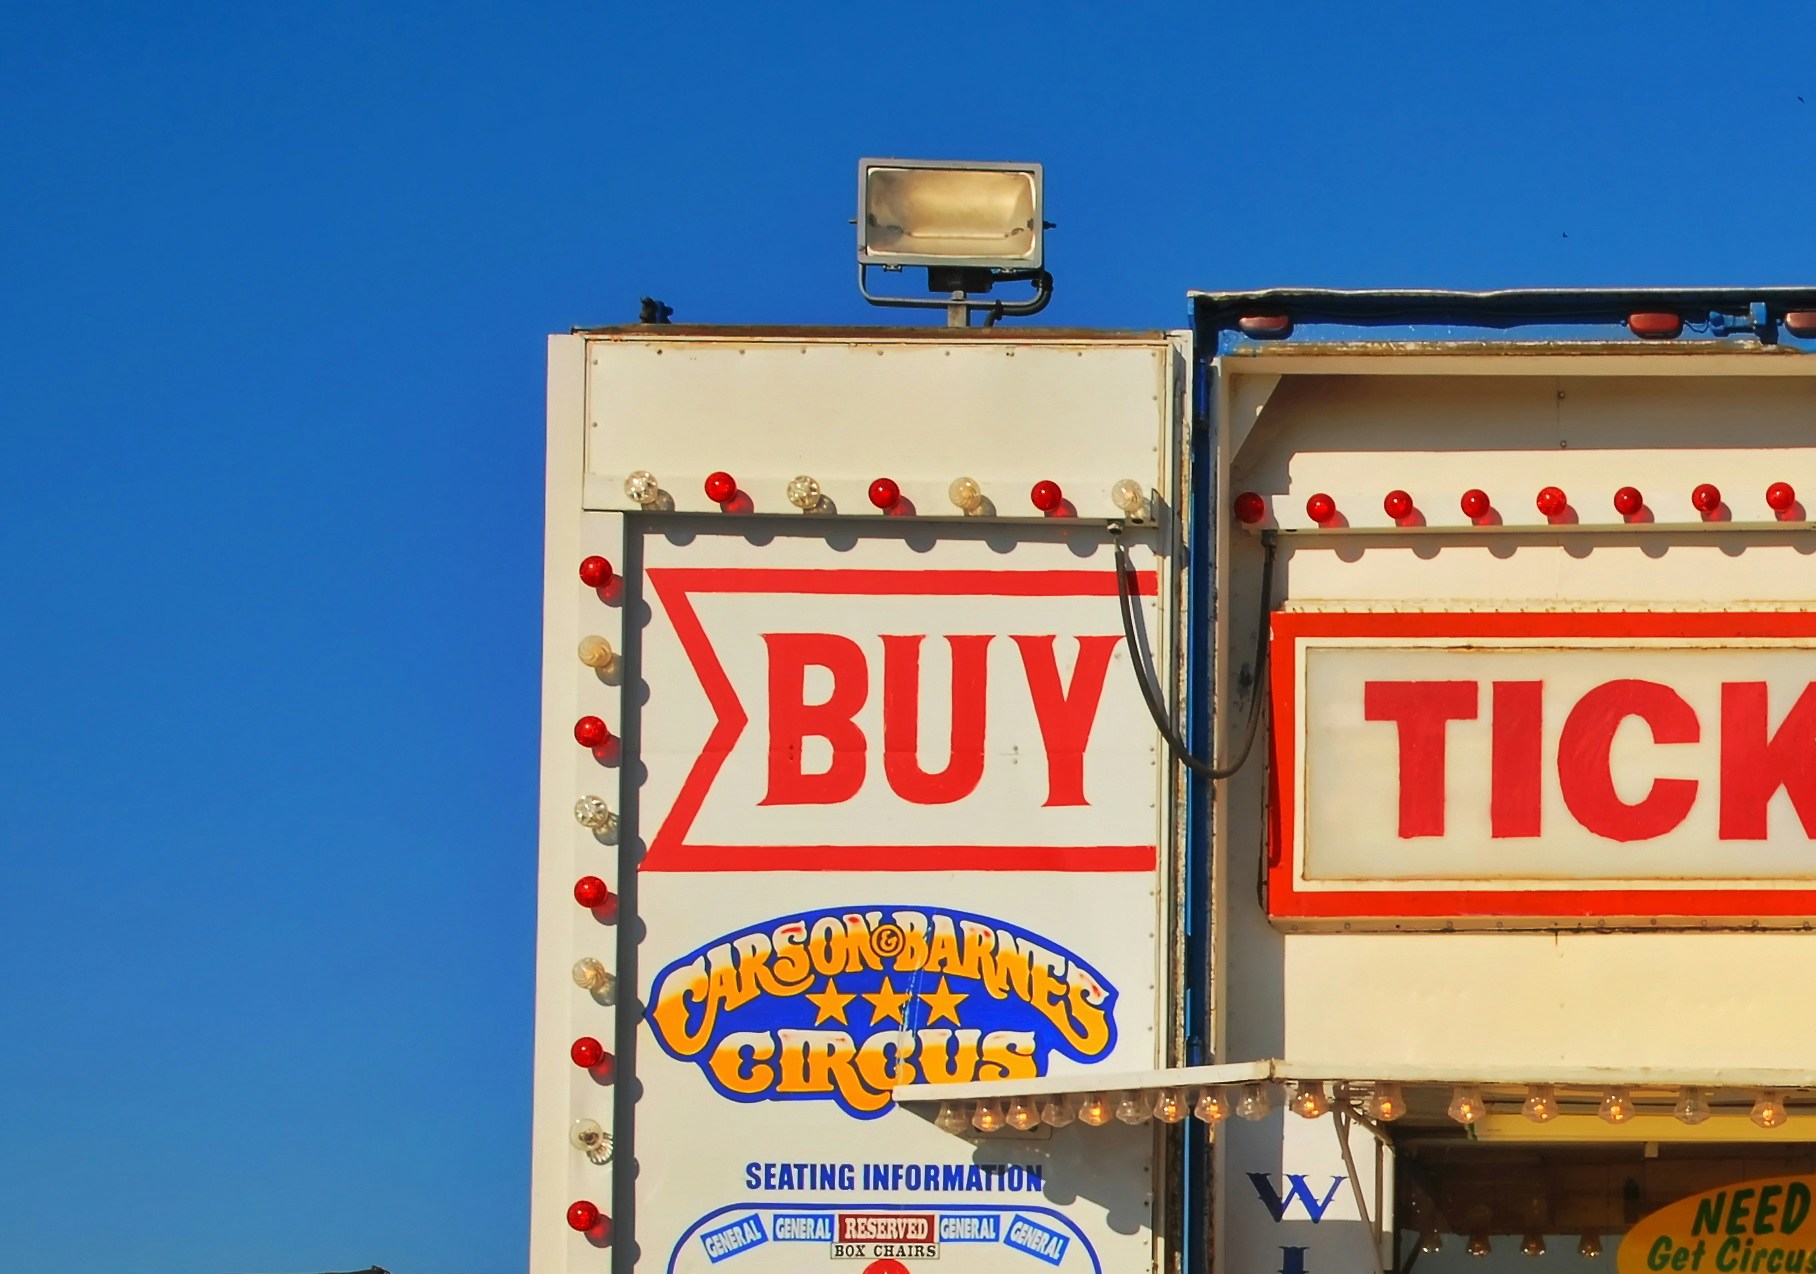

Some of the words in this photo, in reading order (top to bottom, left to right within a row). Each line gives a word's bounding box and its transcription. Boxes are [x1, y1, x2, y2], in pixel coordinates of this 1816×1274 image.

[757, 632, 1125, 807] BUY
[651, 913, 882, 1055] CARSON
[873, 927, 902, 956] &
[893, 913, 1110, 1055] BARNES
[709, 1028, 1037, 1112] CIRCUS
[745, 1162, 856, 1192] SEATING
[862, 1163, 1043, 1192] INFORMATION
[774, 1217, 832, 1240] GENERAL
[844, 1217, 929, 1239] RESERVED
[940, 1216, 997, 1240] GENERAL
[1691, 1181, 1811, 1237] NEED
[705, 1217, 764, 1260] GENERAL
[834, 1244, 866, 1258] BOX
[873, 1244, 936, 1258] CHAIRS
[1010, 1219, 1064, 1261] GENERAL
[1647, 1235, 1705, 1272] Get
